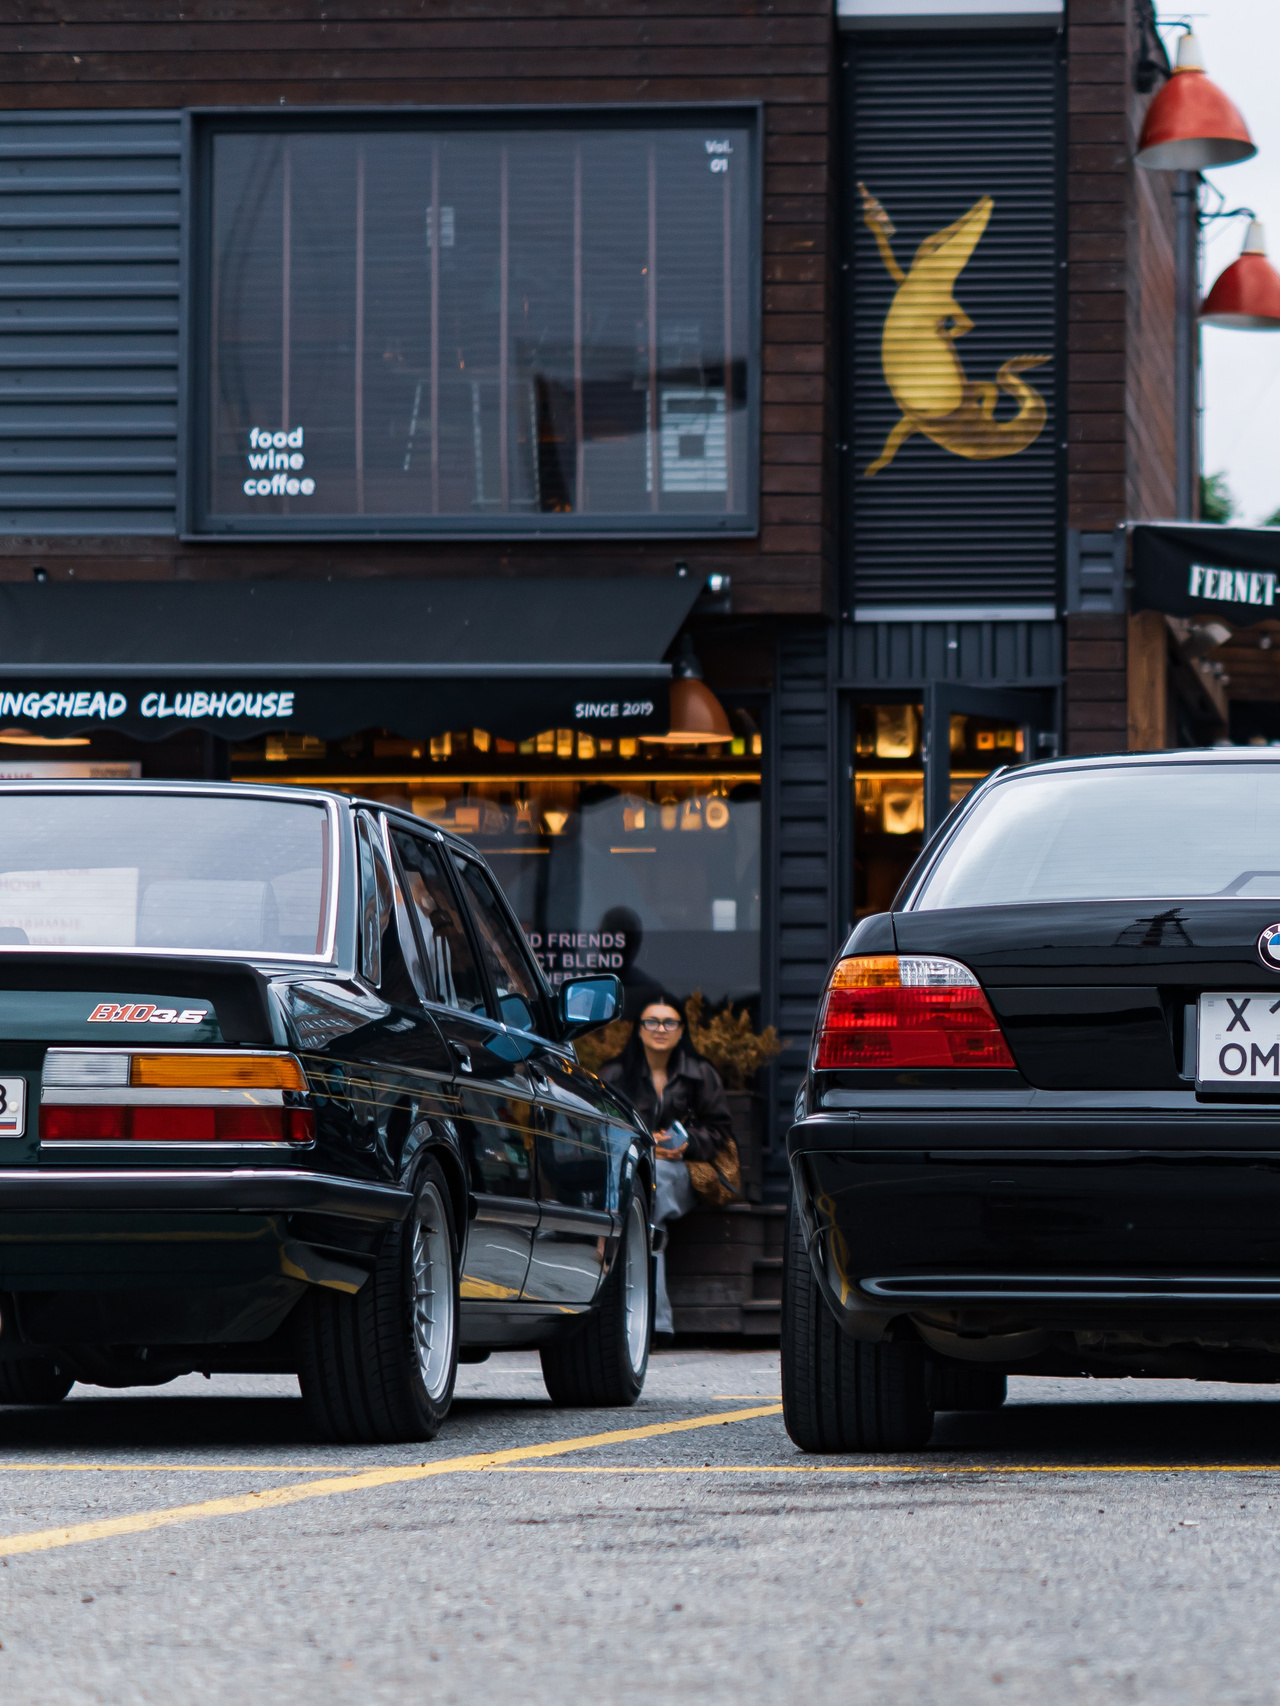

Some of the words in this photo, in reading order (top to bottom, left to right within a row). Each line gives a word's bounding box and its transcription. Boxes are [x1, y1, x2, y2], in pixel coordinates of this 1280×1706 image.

[705, 140, 733, 154] Vol.
[710, 159, 728, 173] 01
[250, 426, 304, 449] food
[248, 448, 304, 470] wine
[243, 473, 316, 496] coffee
[141, 692, 294, 718] CLUBHOUSE
[575, 703, 620, 718] SINCE
[621, 701, 654, 717] 2019
[547, 932, 626, 948] FRIENDS
[562, 953, 623, 968] BLEND
[87, 1003, 157, 1022] B10
